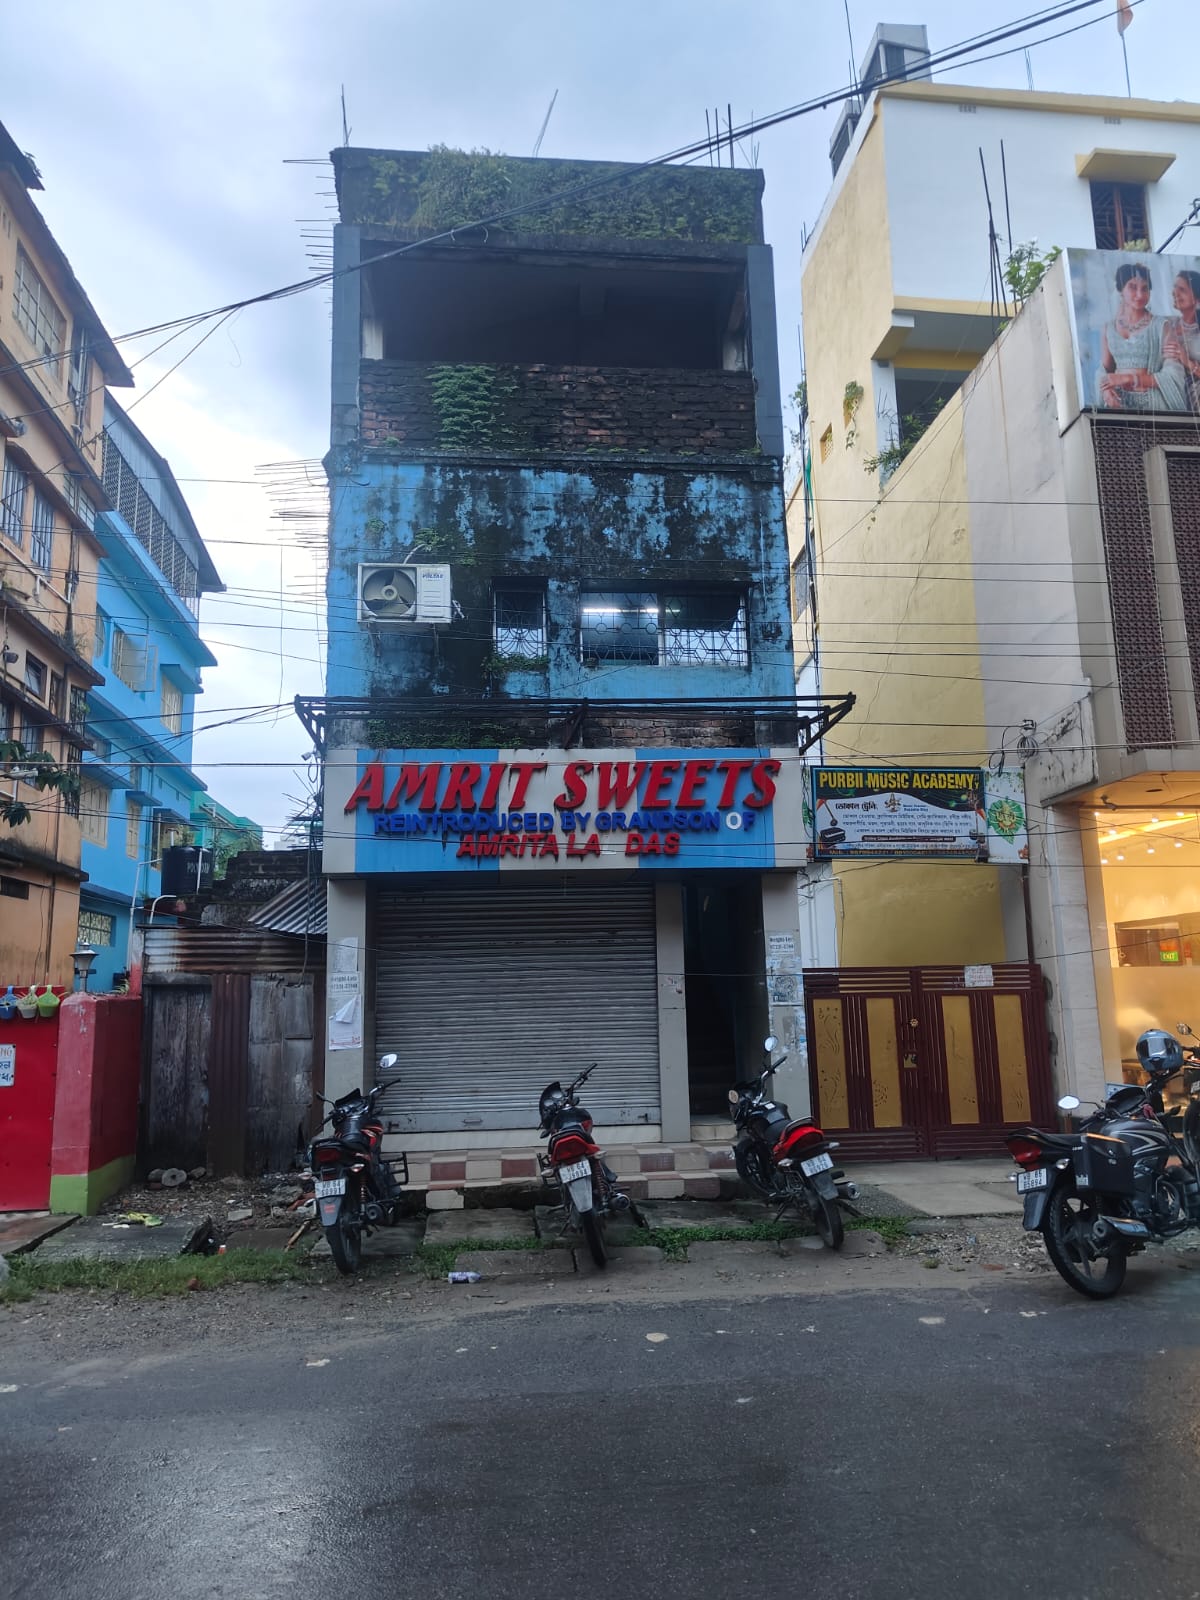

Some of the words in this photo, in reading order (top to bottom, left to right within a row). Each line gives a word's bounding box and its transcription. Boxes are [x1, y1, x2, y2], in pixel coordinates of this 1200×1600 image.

[343, 761, 547, 813] AMRIT
[554, 759, 782, 810] SWEETS
[867, 772, 910, 789] MUSIC
[912, 772, 975, 790] ACADEMY
[374, 812, 554, 834] REINTRODUCED
[560, 812, 591, 833] BY
[594, 811, 720, 833] GRANDSON
[725, 811, 756, 832] OF
[456, 833, 560, 859] AMRITA
[625, 832, 681, 856] DAS
